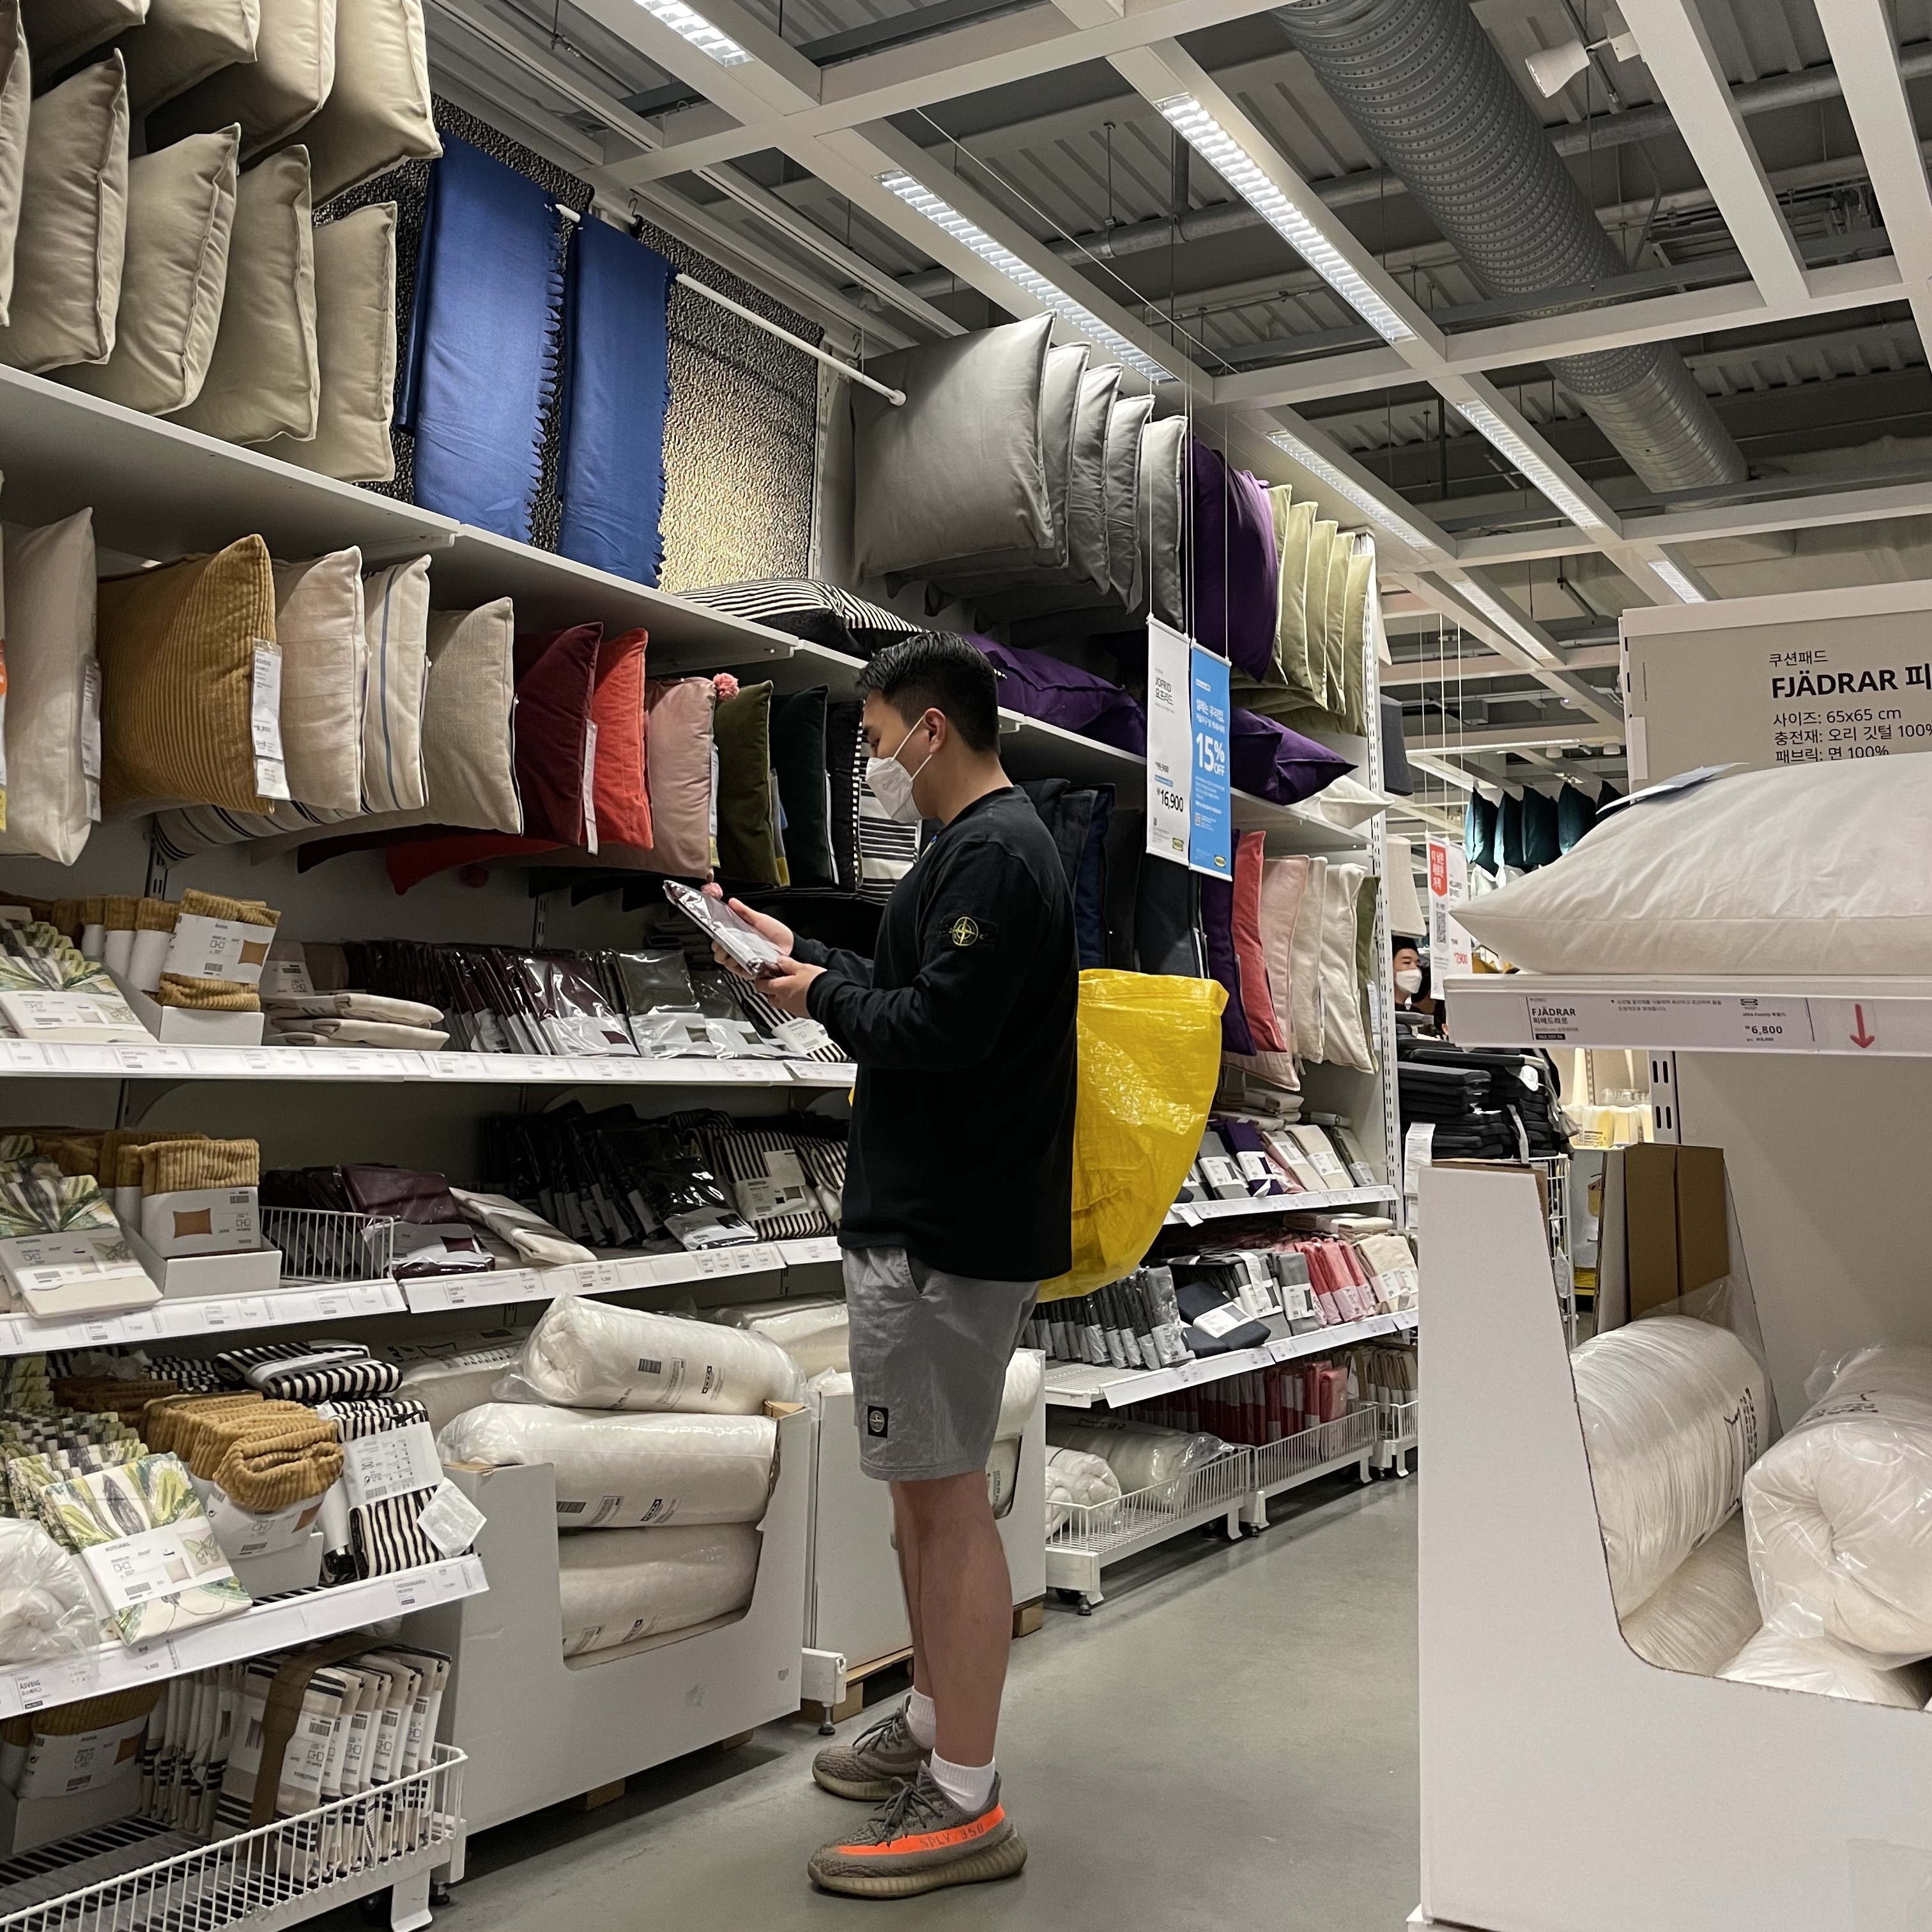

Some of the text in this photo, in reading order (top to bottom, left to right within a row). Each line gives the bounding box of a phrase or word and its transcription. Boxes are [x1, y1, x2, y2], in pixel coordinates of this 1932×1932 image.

[1769, 650, 1828, 667] 쿠션패드
[1772, 670, 1899, 698] FJÄDRAR
[1774, 709, 1901, 727] 사이즈: 65x65 cm
[1774, 729, 1823, 746] 충전재:
[1828, 726, 1857, 741] 오리
[1863, 724, 1892, 740] 깃털
[1775, 747, 1823, 763] 패브릭:
[1828, 746, 1843, 761] 면
[1531, 1006, 1576, 1016] FJÄDRAR
